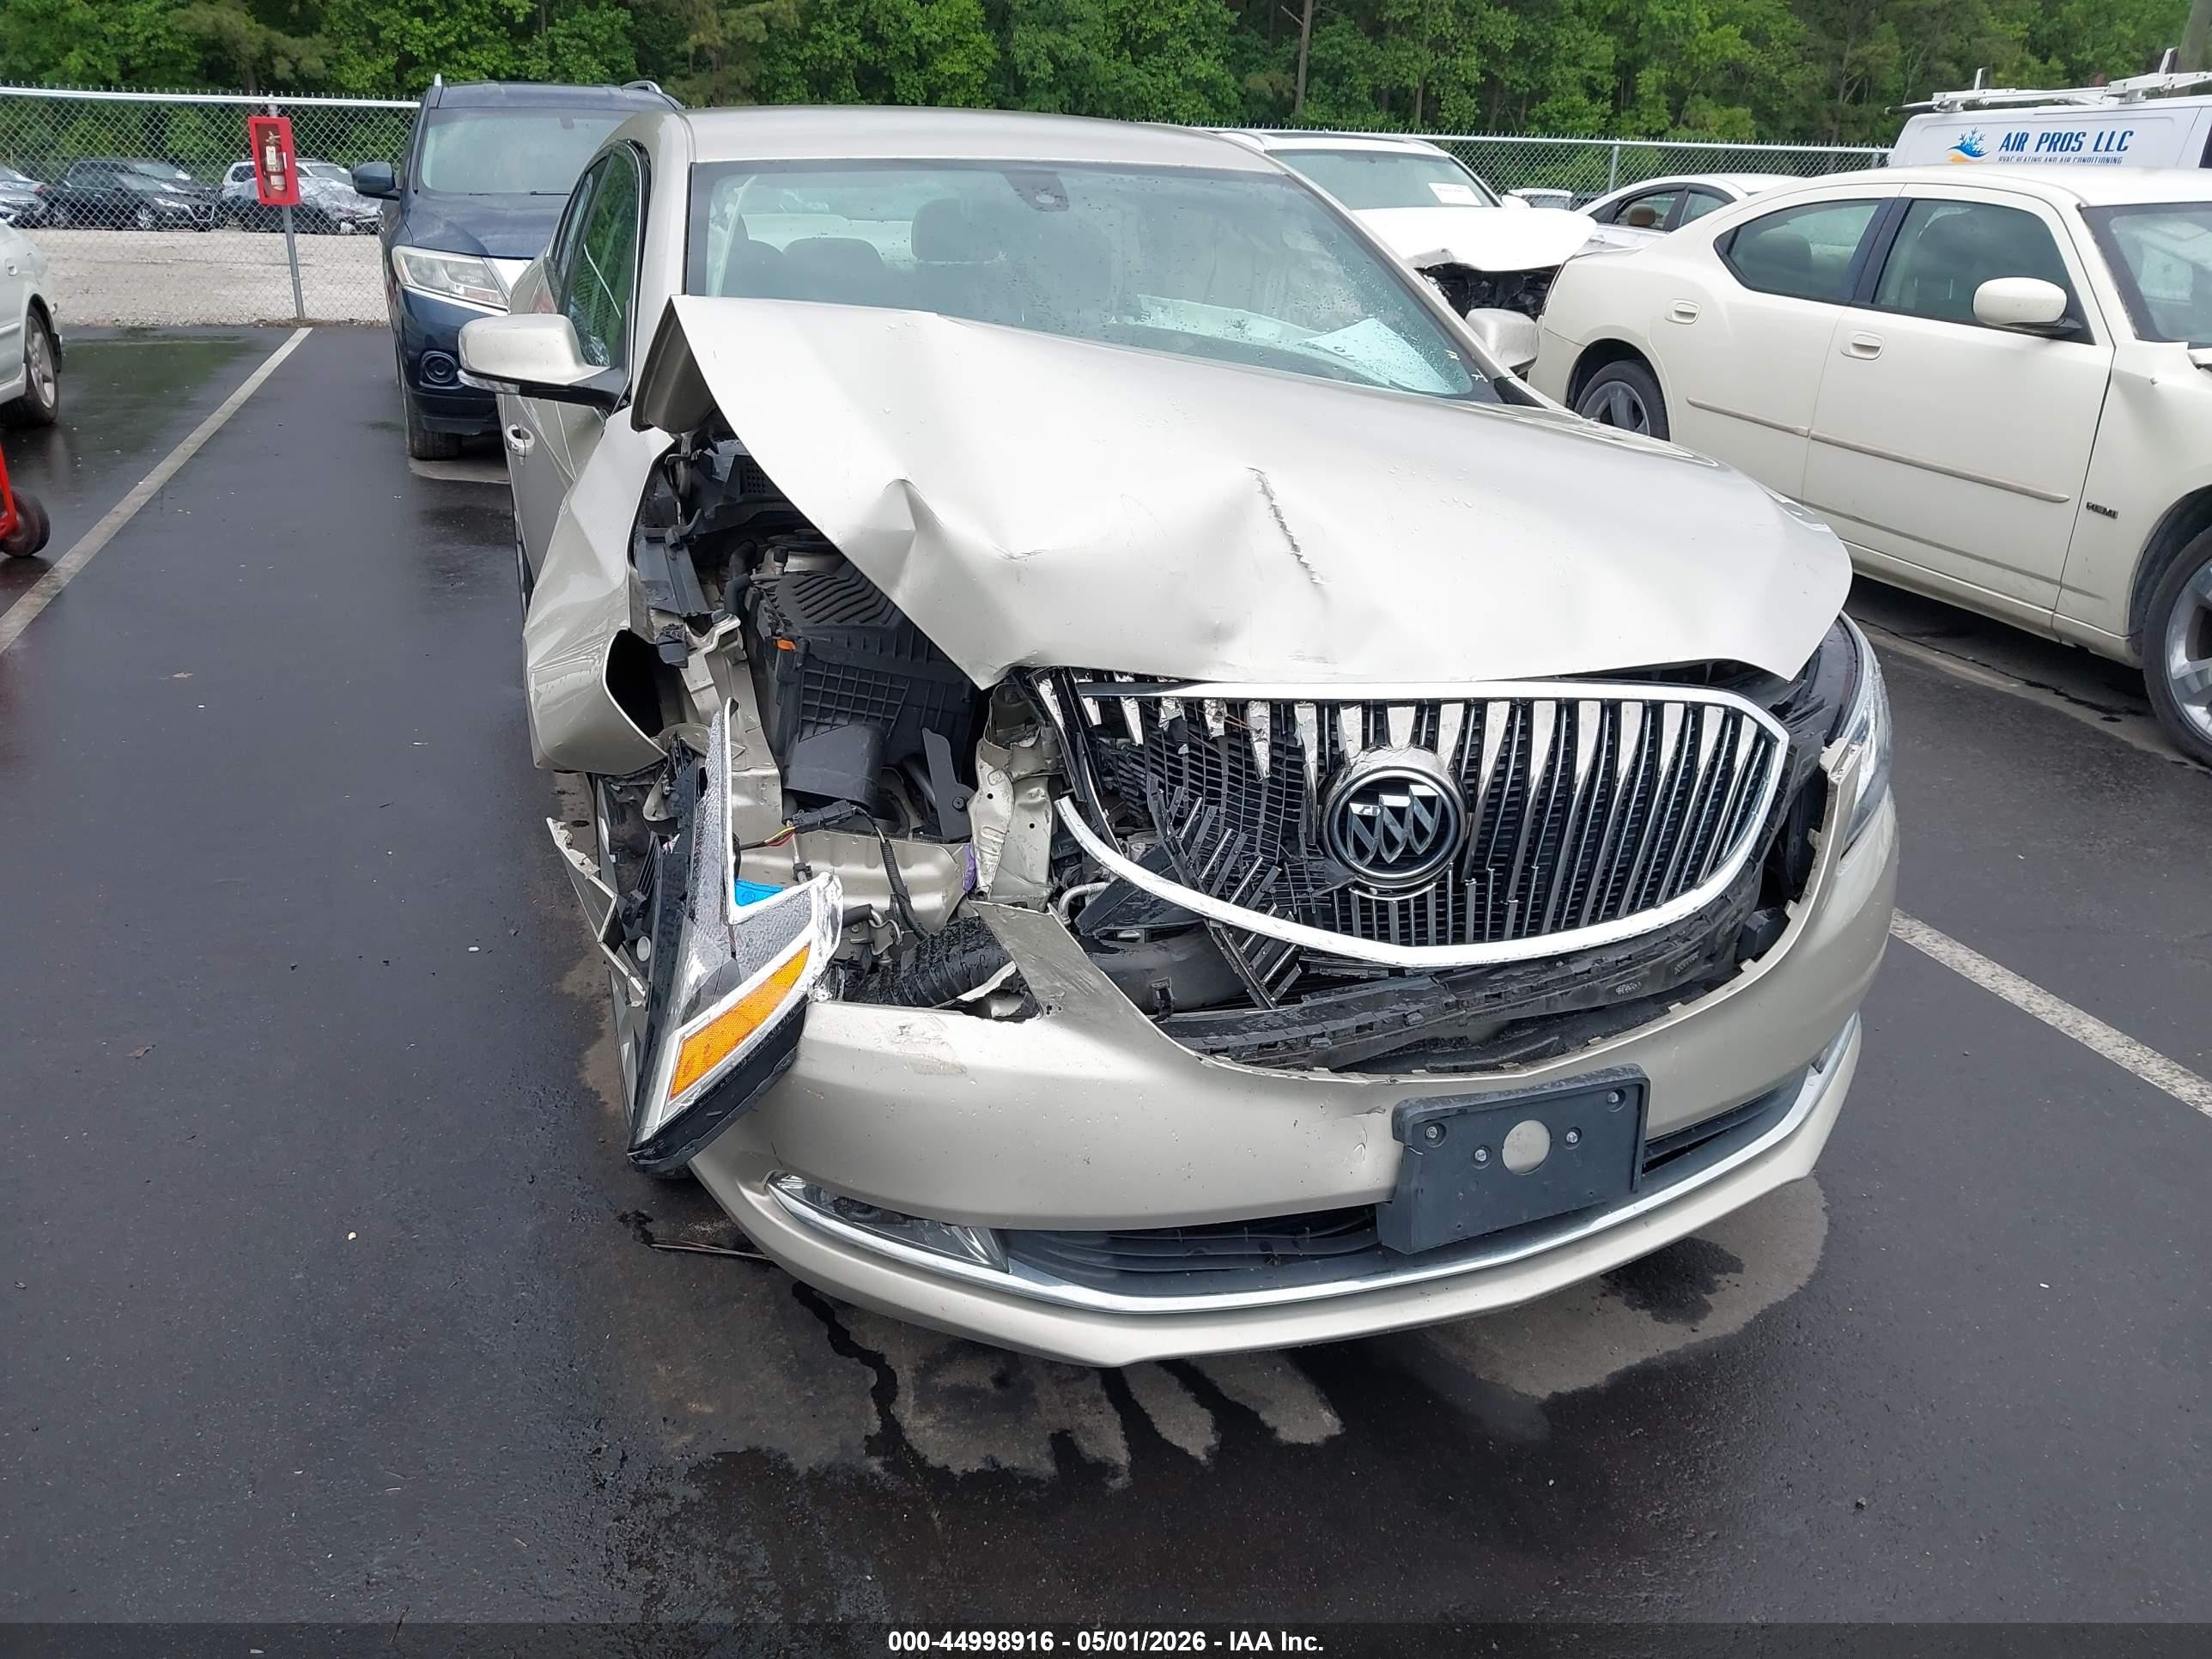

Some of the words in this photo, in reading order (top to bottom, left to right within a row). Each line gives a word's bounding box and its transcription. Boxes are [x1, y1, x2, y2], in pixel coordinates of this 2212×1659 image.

[1998, 131, 2030, 152] AIR
[2034, 131, 2087, 153] PROS
[2093, 130, 2134, 152] LLC
